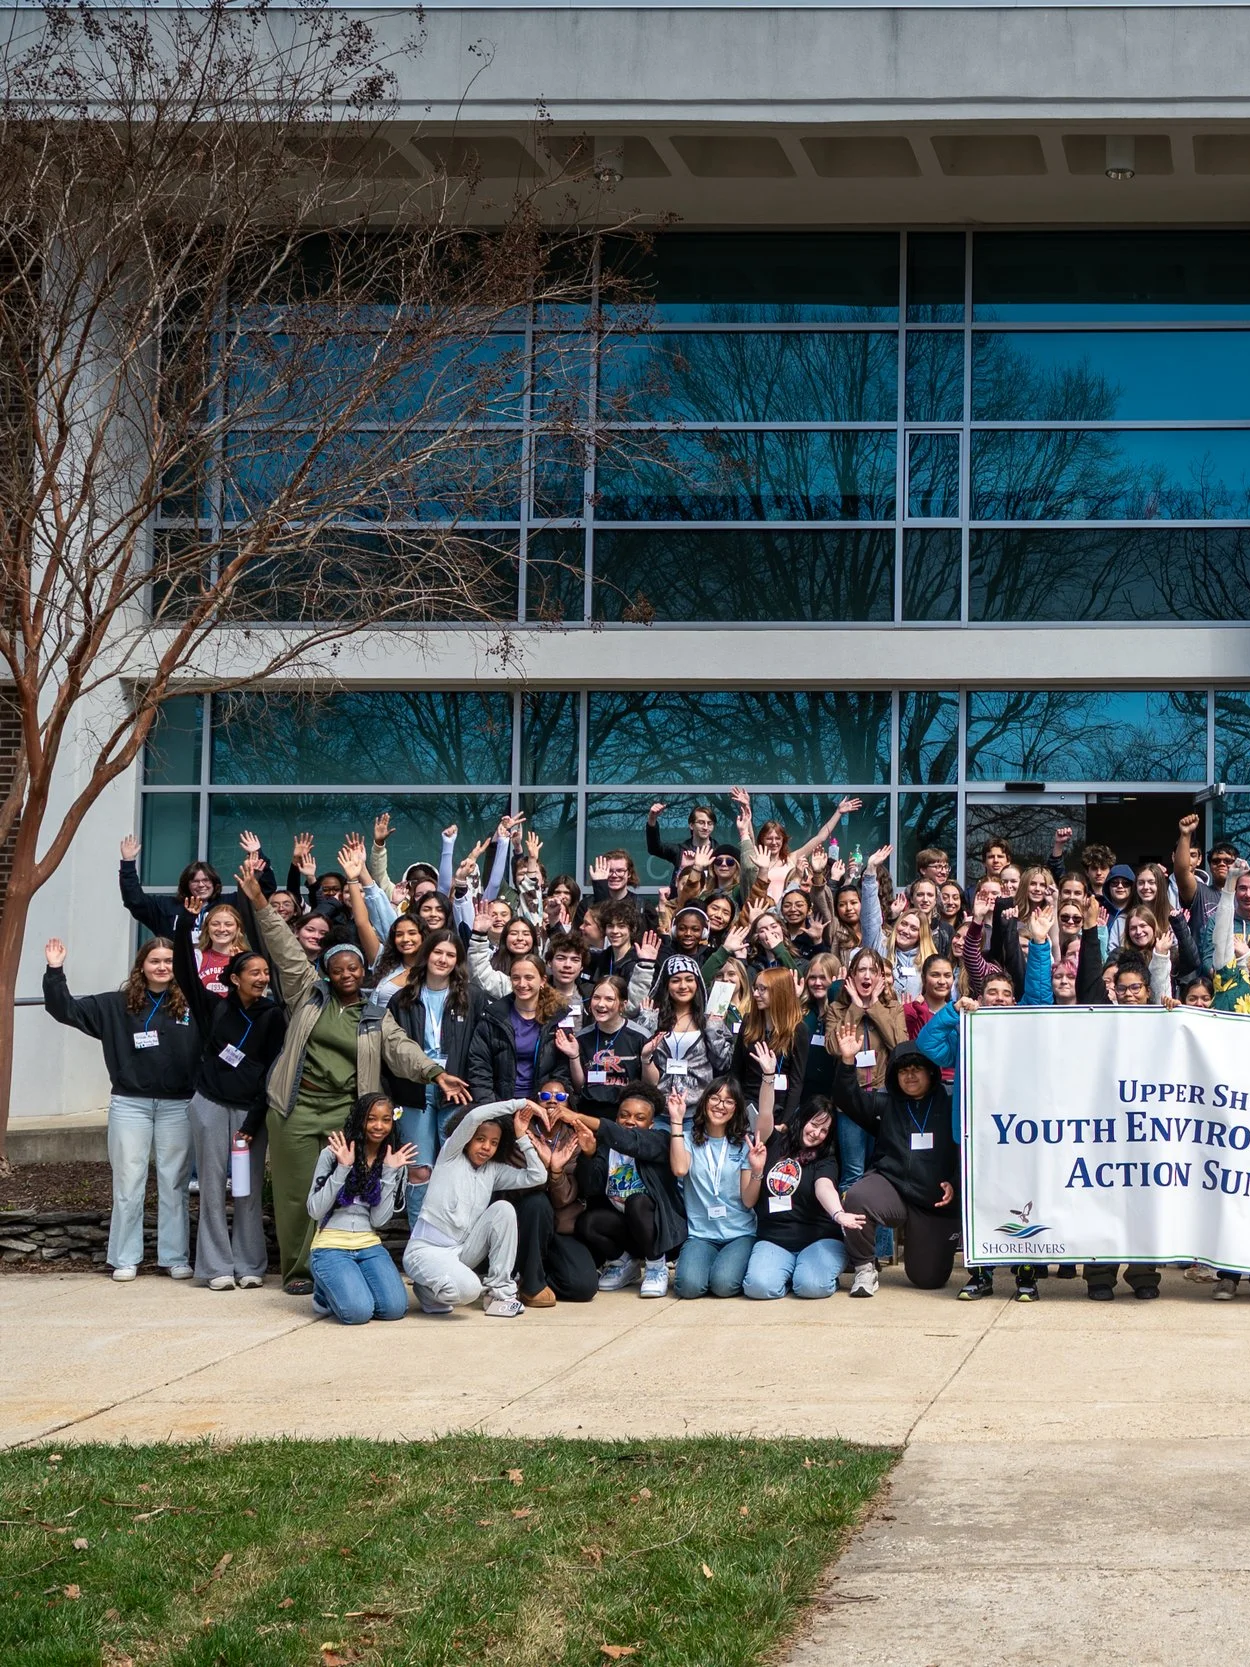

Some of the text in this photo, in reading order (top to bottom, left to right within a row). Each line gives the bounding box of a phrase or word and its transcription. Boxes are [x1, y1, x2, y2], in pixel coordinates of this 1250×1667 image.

[1117, 1079, 1206, 1106] UPPER
[990, 1113, 1117, 1145] YOUTH
[1064, 1157, 1193, 1188] ACTION
[982, 1241, 1066, 1255] SHORERIVERS
